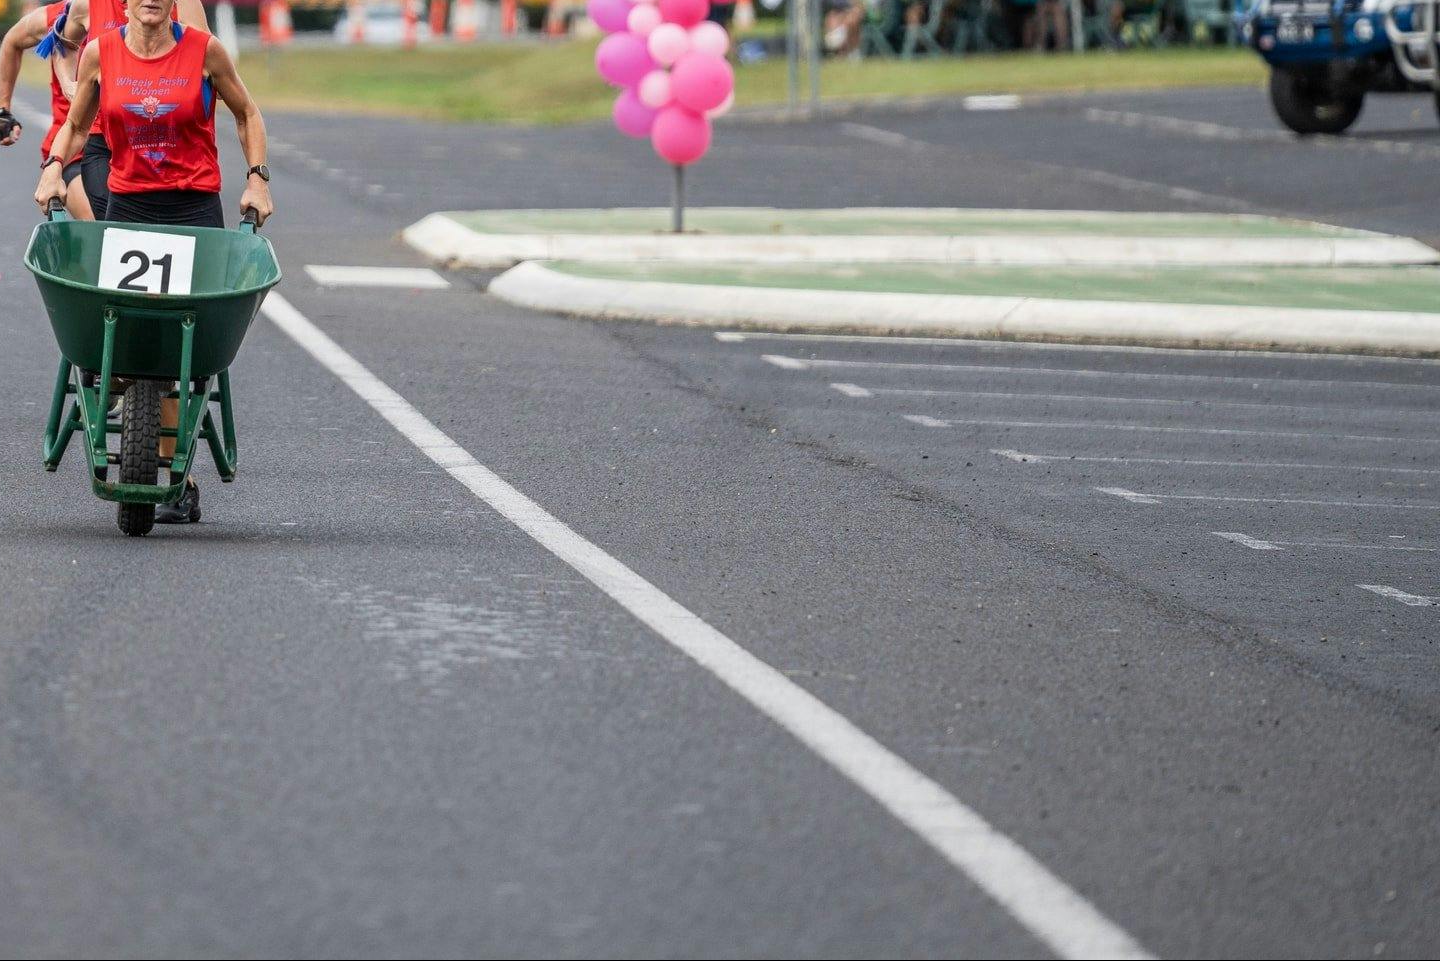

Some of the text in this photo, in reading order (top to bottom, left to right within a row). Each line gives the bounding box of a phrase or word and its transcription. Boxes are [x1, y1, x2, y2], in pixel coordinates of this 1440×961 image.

[116, 76, 188, 88] Wheely Pushy
[131, 87, 170, 96] Women
[117, 249, 173, 294] 21
